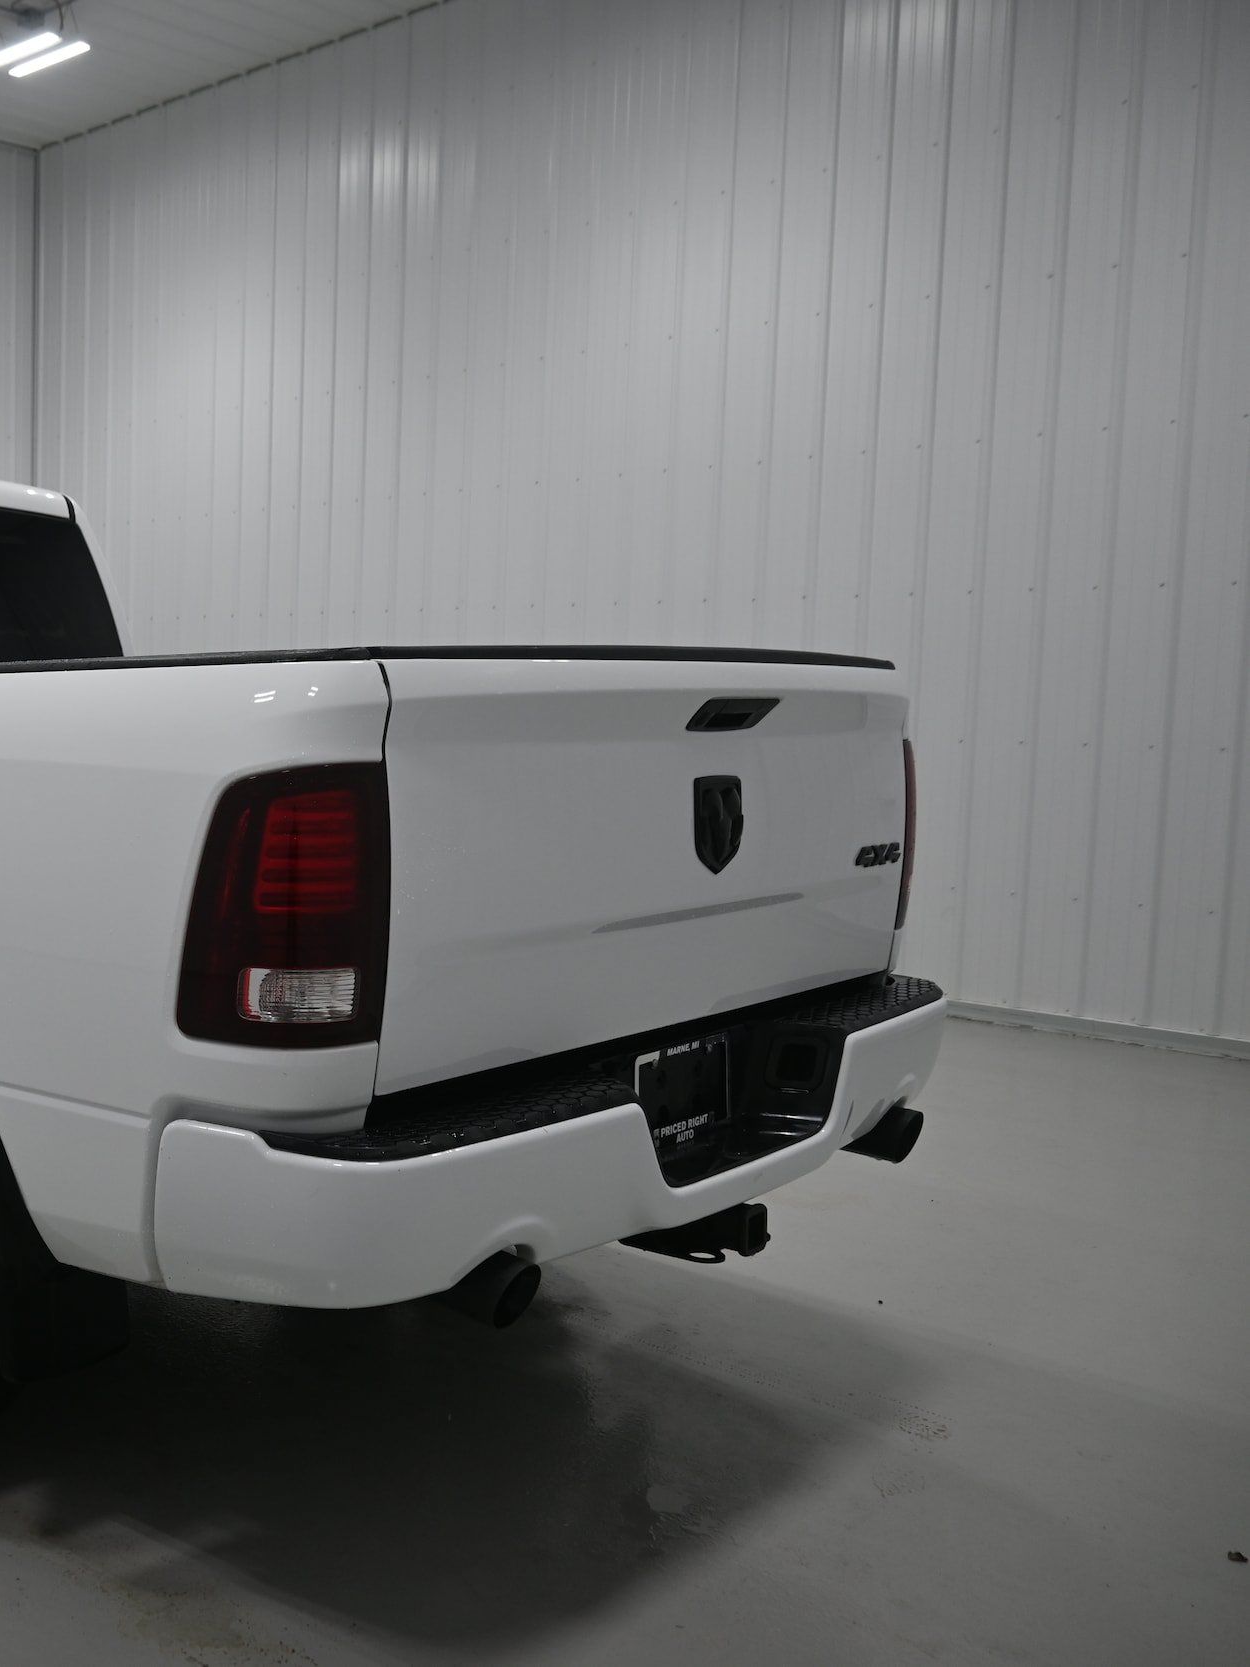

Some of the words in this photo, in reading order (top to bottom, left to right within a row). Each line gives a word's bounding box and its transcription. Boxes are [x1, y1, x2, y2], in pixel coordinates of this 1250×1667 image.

[690, 1040, 700, 1051] MI
[660, 1120, 687, 1138] PRICED
[687, 1113, 709, 1128] RIGHT
[675, 1129, 695, 1144] AUTO
